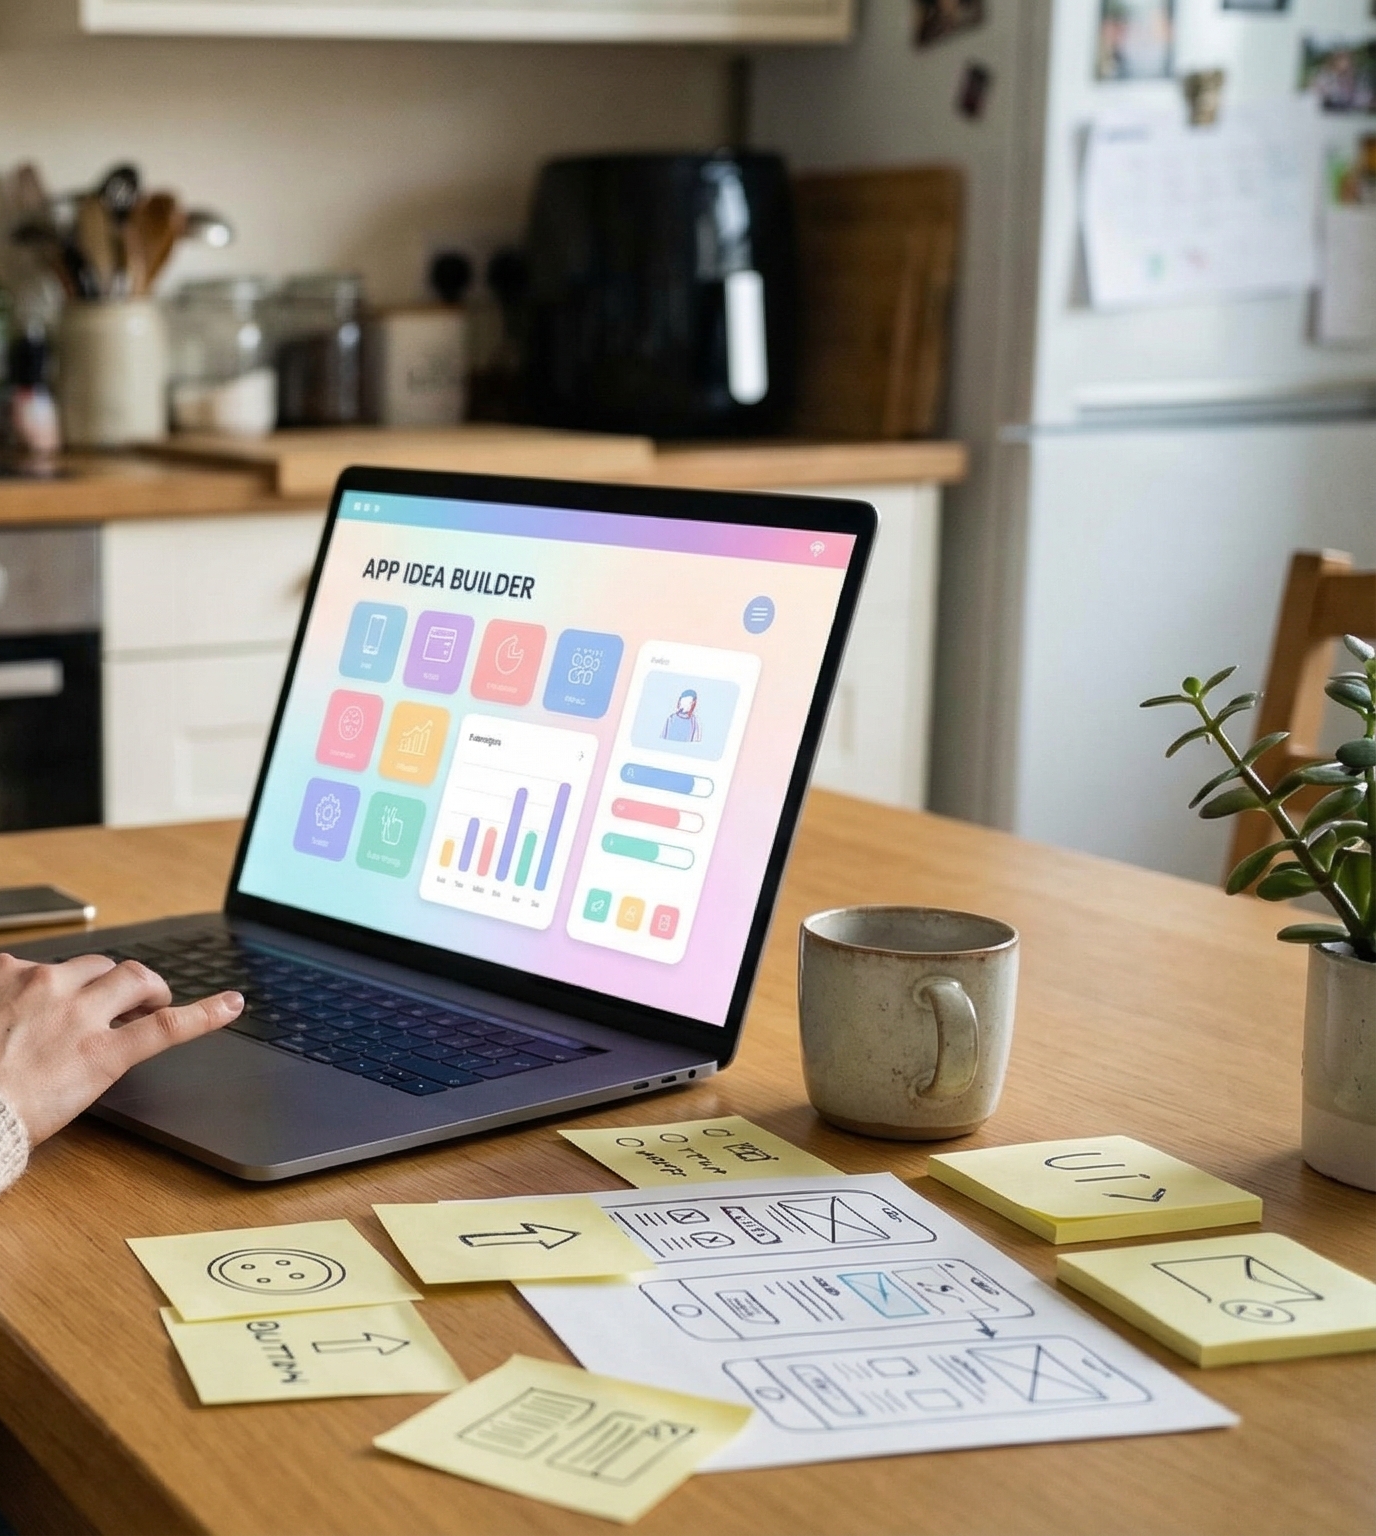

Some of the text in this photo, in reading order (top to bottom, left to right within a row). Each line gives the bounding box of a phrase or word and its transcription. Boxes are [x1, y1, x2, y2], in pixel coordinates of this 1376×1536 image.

[362, 558, 535, 599] APP IDEA BUILDER
